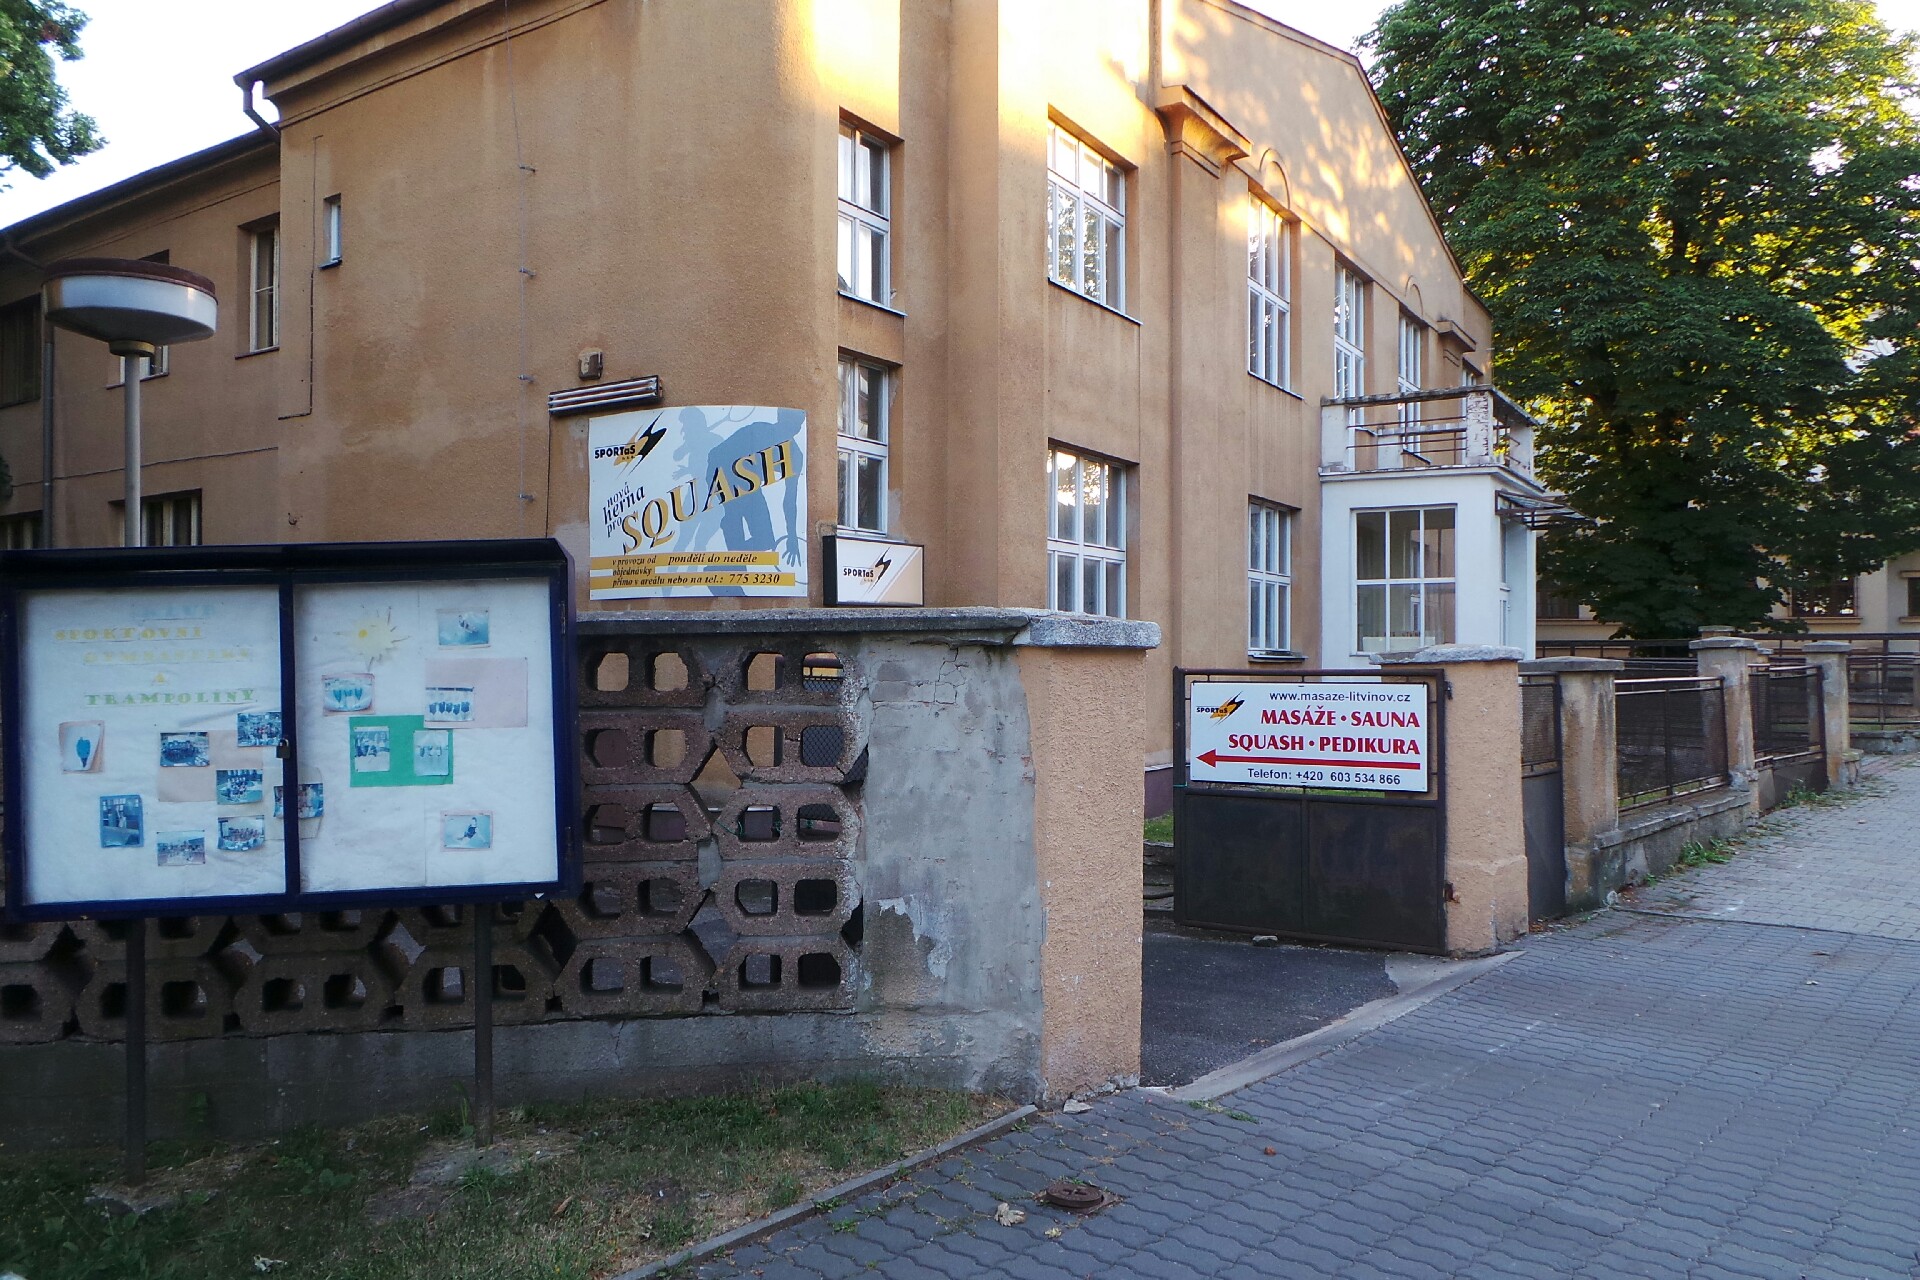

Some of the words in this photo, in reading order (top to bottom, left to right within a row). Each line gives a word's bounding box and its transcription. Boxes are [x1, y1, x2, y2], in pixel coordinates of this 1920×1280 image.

[606, 516, 622, 538] pro
[622, 439, 796, 556] SQUASH
[607, 481, 630, 508] nová
[602, 486, 645, 525] herna
[647, 555, 657, 564] od
[668, 553, 706, 566] pondělí
[707, 553, 721, 563] do
[723, 553, 758, 563] neděle
[612, 566, 652, 577] objednávky
[640, 575, 665, 586] areálu
[667, 575, 688, 584] nebo
[690, 576, 702, 584] na
[729, 573, 750, 584] 775
[752, 573, 780, 584] 3230
[1269, 691, 1411, 702] www.masaze-litvinov.cz
[1260, 705, 1337, 726] MASÁŽE
[1350, 711, 1421, 728] SAUNA
[1228, 734, 1304, 752] SQUASH
[1319, 736, 1421, 755] PEDIKURA
[1248, 768, 1292, 780] Telefon:
[1295, 770, 1324, 781] +420
[1330, 771, 1351, 783] 603
[1354, 772, 1376, 784] 534
[1379, 774, 1401, 785] 866
